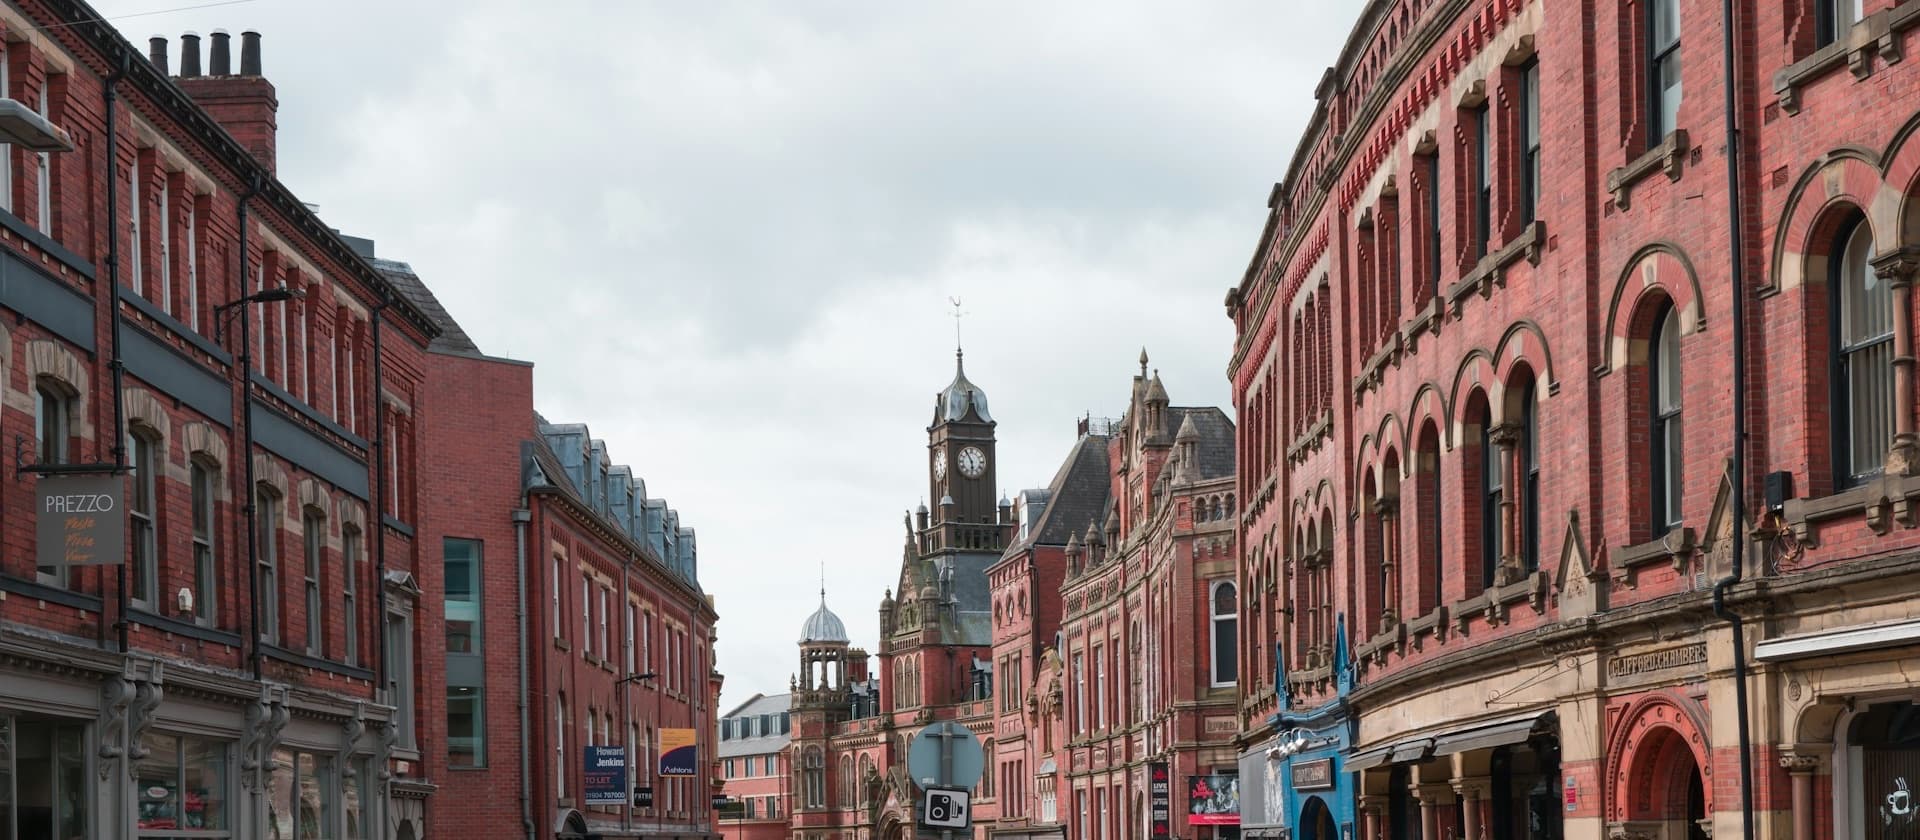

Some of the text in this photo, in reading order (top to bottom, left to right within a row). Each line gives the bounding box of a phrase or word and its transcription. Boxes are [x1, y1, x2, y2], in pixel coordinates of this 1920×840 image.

[46, 494, 114, 513] PREZZO
[596, 747, 624, 756] Howard
[596, 758, 624, 767] Jenkins
[663, 766, 693, 774] Ashtons
[585, 776, 611, 784] TO LET
[603, 791, 626, 799] 707000
